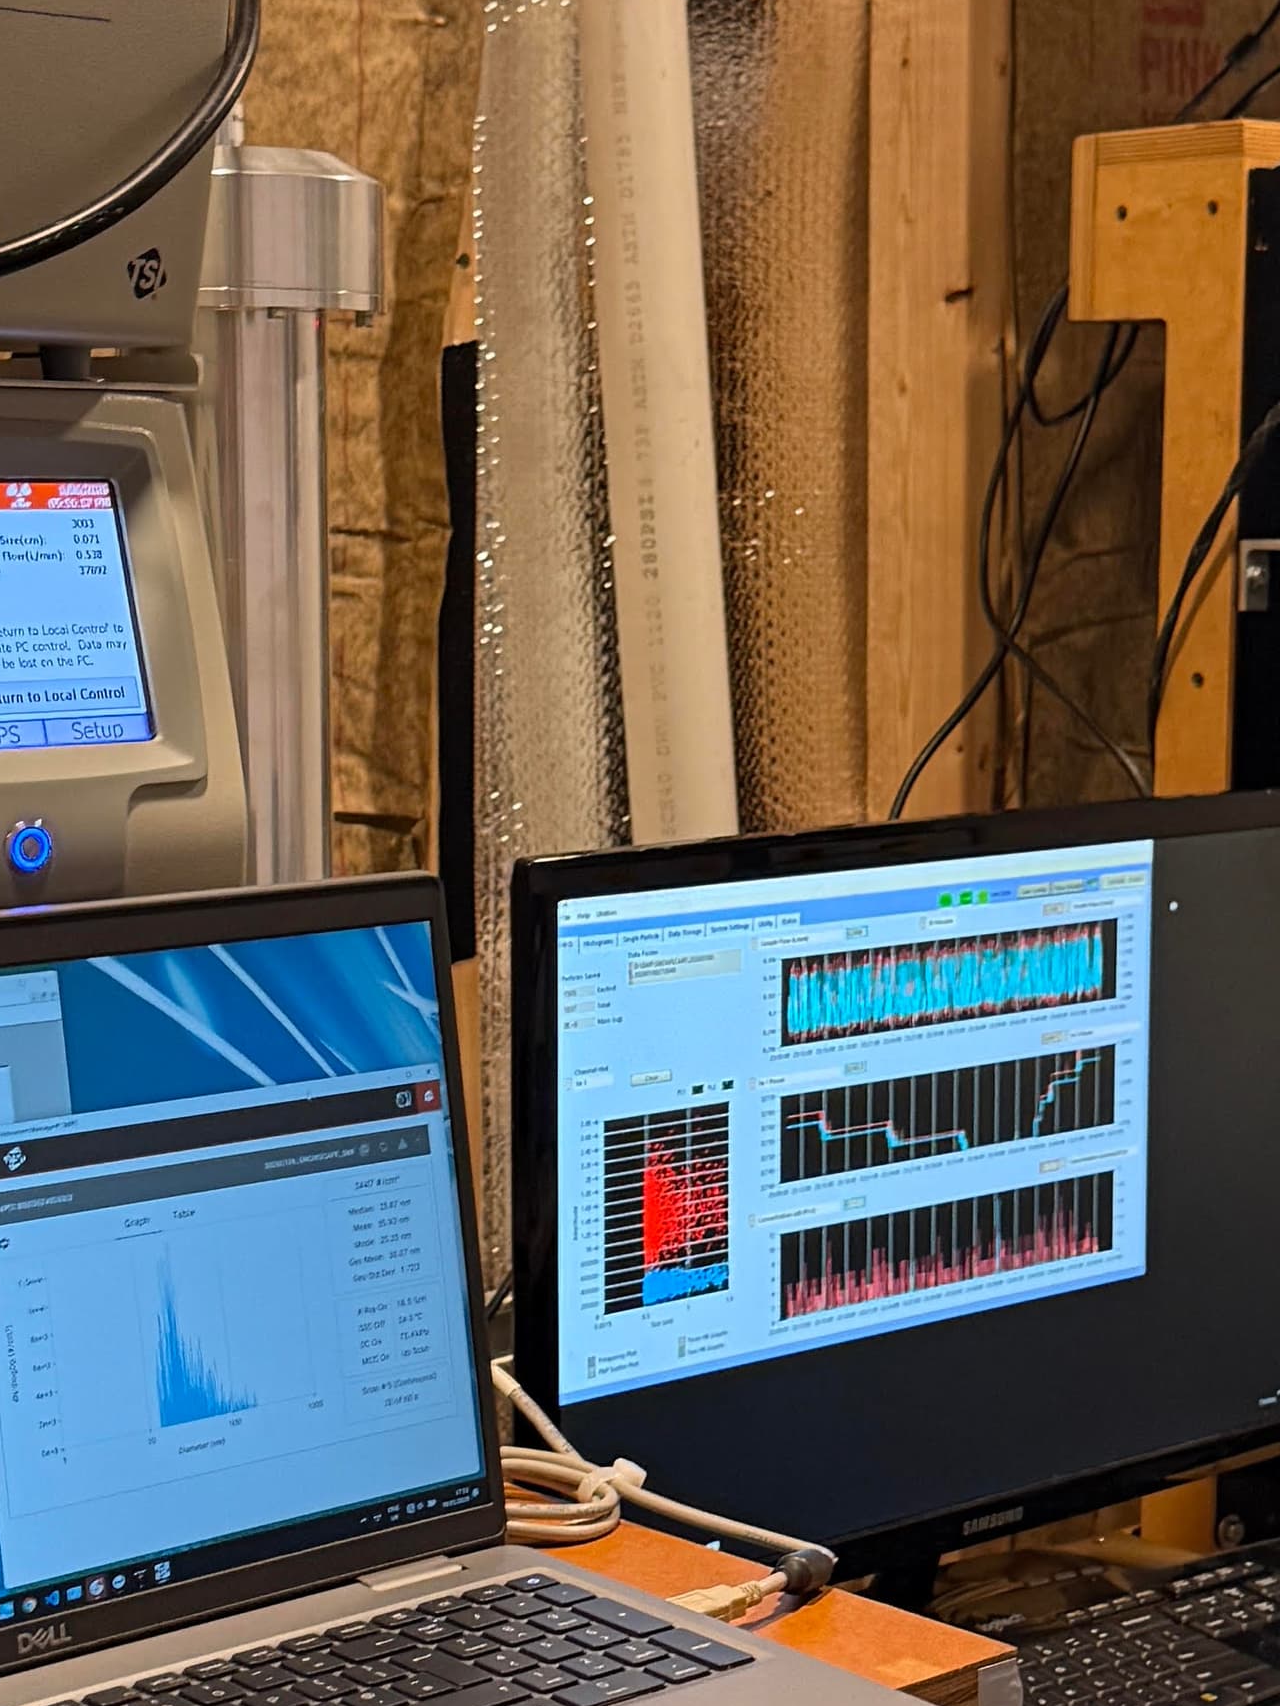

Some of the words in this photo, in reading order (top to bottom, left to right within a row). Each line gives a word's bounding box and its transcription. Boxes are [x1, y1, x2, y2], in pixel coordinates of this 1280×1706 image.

[73, 534, 101, 546] 0.071
[42, 624, 70, 636] Local
[113, 624, 125, 634] to
[16, 642, 30, 653] PC
[78, 639, 103, 651] Data
[105, 640, 128, 652] may
[2, 658, 16, 669] be
[19, 657, 39, 669] lost
[56, 656, 74, 668] the
[27, 691, 42, 704] to
[44, 689, 78, 703] Local
[80, 686, 126, 701] Control
[72, 721, 125, 743] Setup
[17, 1622, 73, 1654] DELL
